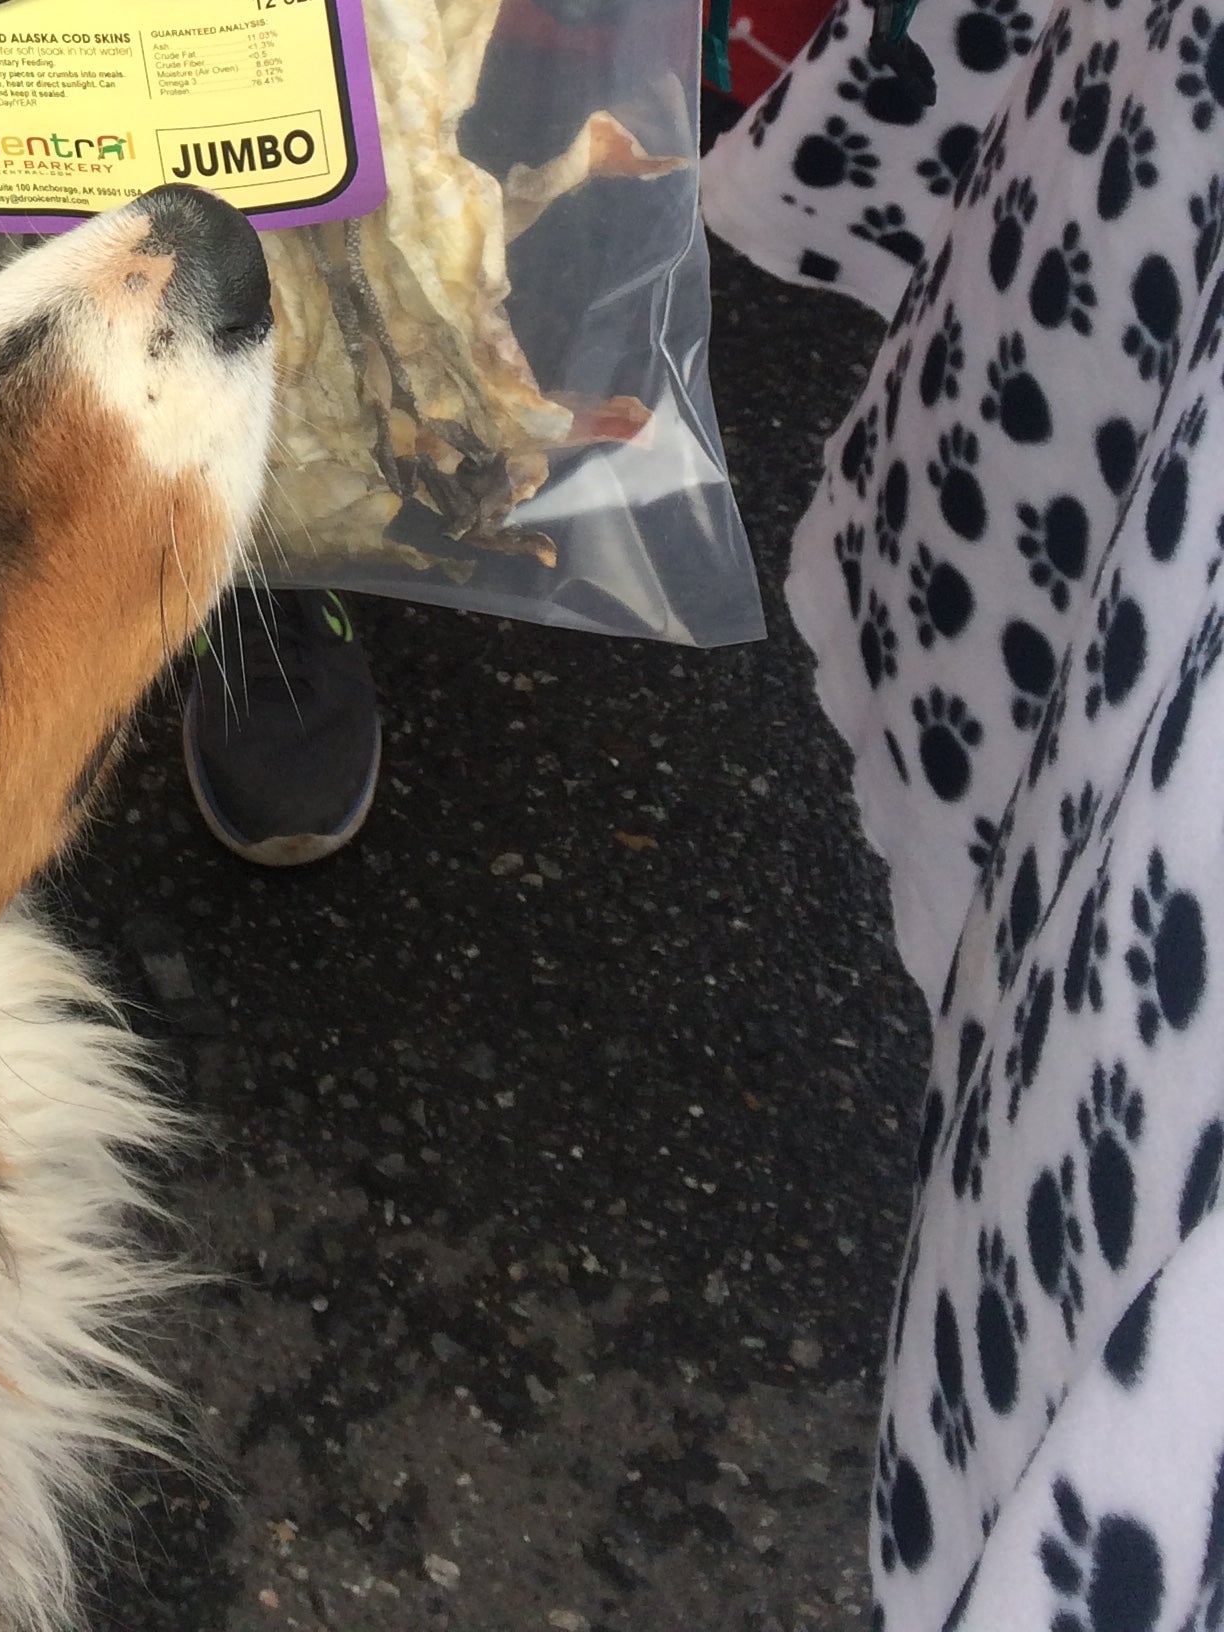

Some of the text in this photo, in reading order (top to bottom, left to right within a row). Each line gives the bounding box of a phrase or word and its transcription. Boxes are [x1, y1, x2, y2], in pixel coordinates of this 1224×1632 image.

[151, 19, 268, 38] GUARANTEED ANALYSIS:
[11, 33, 58, 43] ALASKA
[62, 34, 90, 43] COD
[95, 34, 130, 43] SKINS
[248, 30, 278, 41] 11.03%
[17, 46, 35, 56] soft
[37, 46, 64, 56] (soak
[68, 46, 76, 55] in
[79, 46, 96, 56] hot
[100, 46, 133, 57] water)
[154, 52, 179, 60] Crude
[156, 61, 181, 69] Crude
[184, 60, 204, 68] Fiber
[9, 71, 34, 79] pieces
[157, 69, 193, 78] Moisture
[196, 68, 209, 77] (Air
[212, 65, 238, 74] Oven)
[159, 80, 189, 88] Omega
[256, 67, 283, 77] 0.12%
[6, 80, 24, 88] heat
[36, 80, 59, 88] direct
[99, 80, 115, 88] Can
[10, 90, 29, 98] keep
[161, 88, 190, 96] Protein
[172, 129, 315, 178] JUMBO
[24, 160, 114, 173] BARKERY
[16, 183, 30, 191] 100
[124, 188, 142, 197] USA
